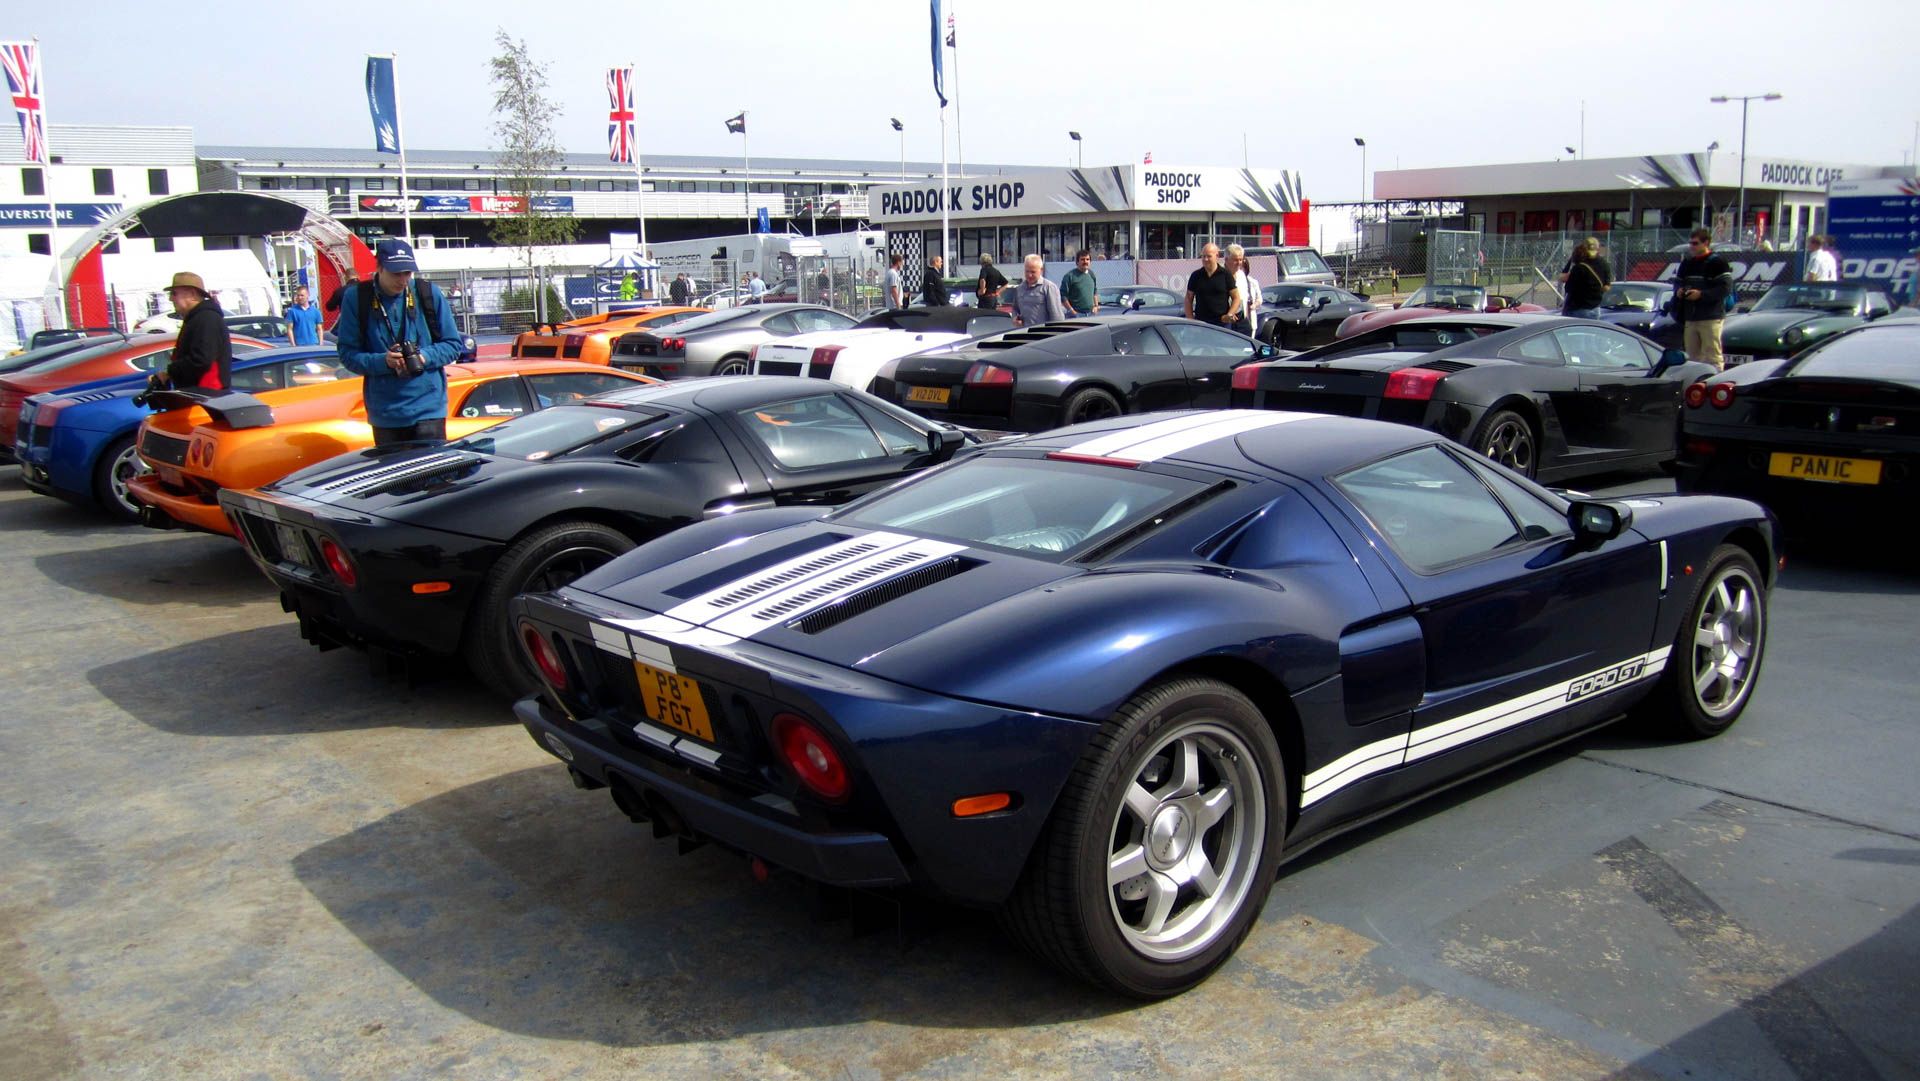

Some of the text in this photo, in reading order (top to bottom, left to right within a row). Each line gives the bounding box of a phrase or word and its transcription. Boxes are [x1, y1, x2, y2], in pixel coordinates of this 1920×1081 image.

[1144, 172, 1201, 187] PADDOCK
[1761, 163, 1813, 185] PADDOCK
[882, 182, 1025, 215] PADDOCK SHOP
[1157, 189, 1190, 203] SHOP
[1657, 261, 1786, 281] AON
[1790, 456, 1829, 476] PAN
[656, 671, 682, 700] P8
[1567, 660, 1645, 700] FORD GT
[656, 696, 692, 730] FGT
